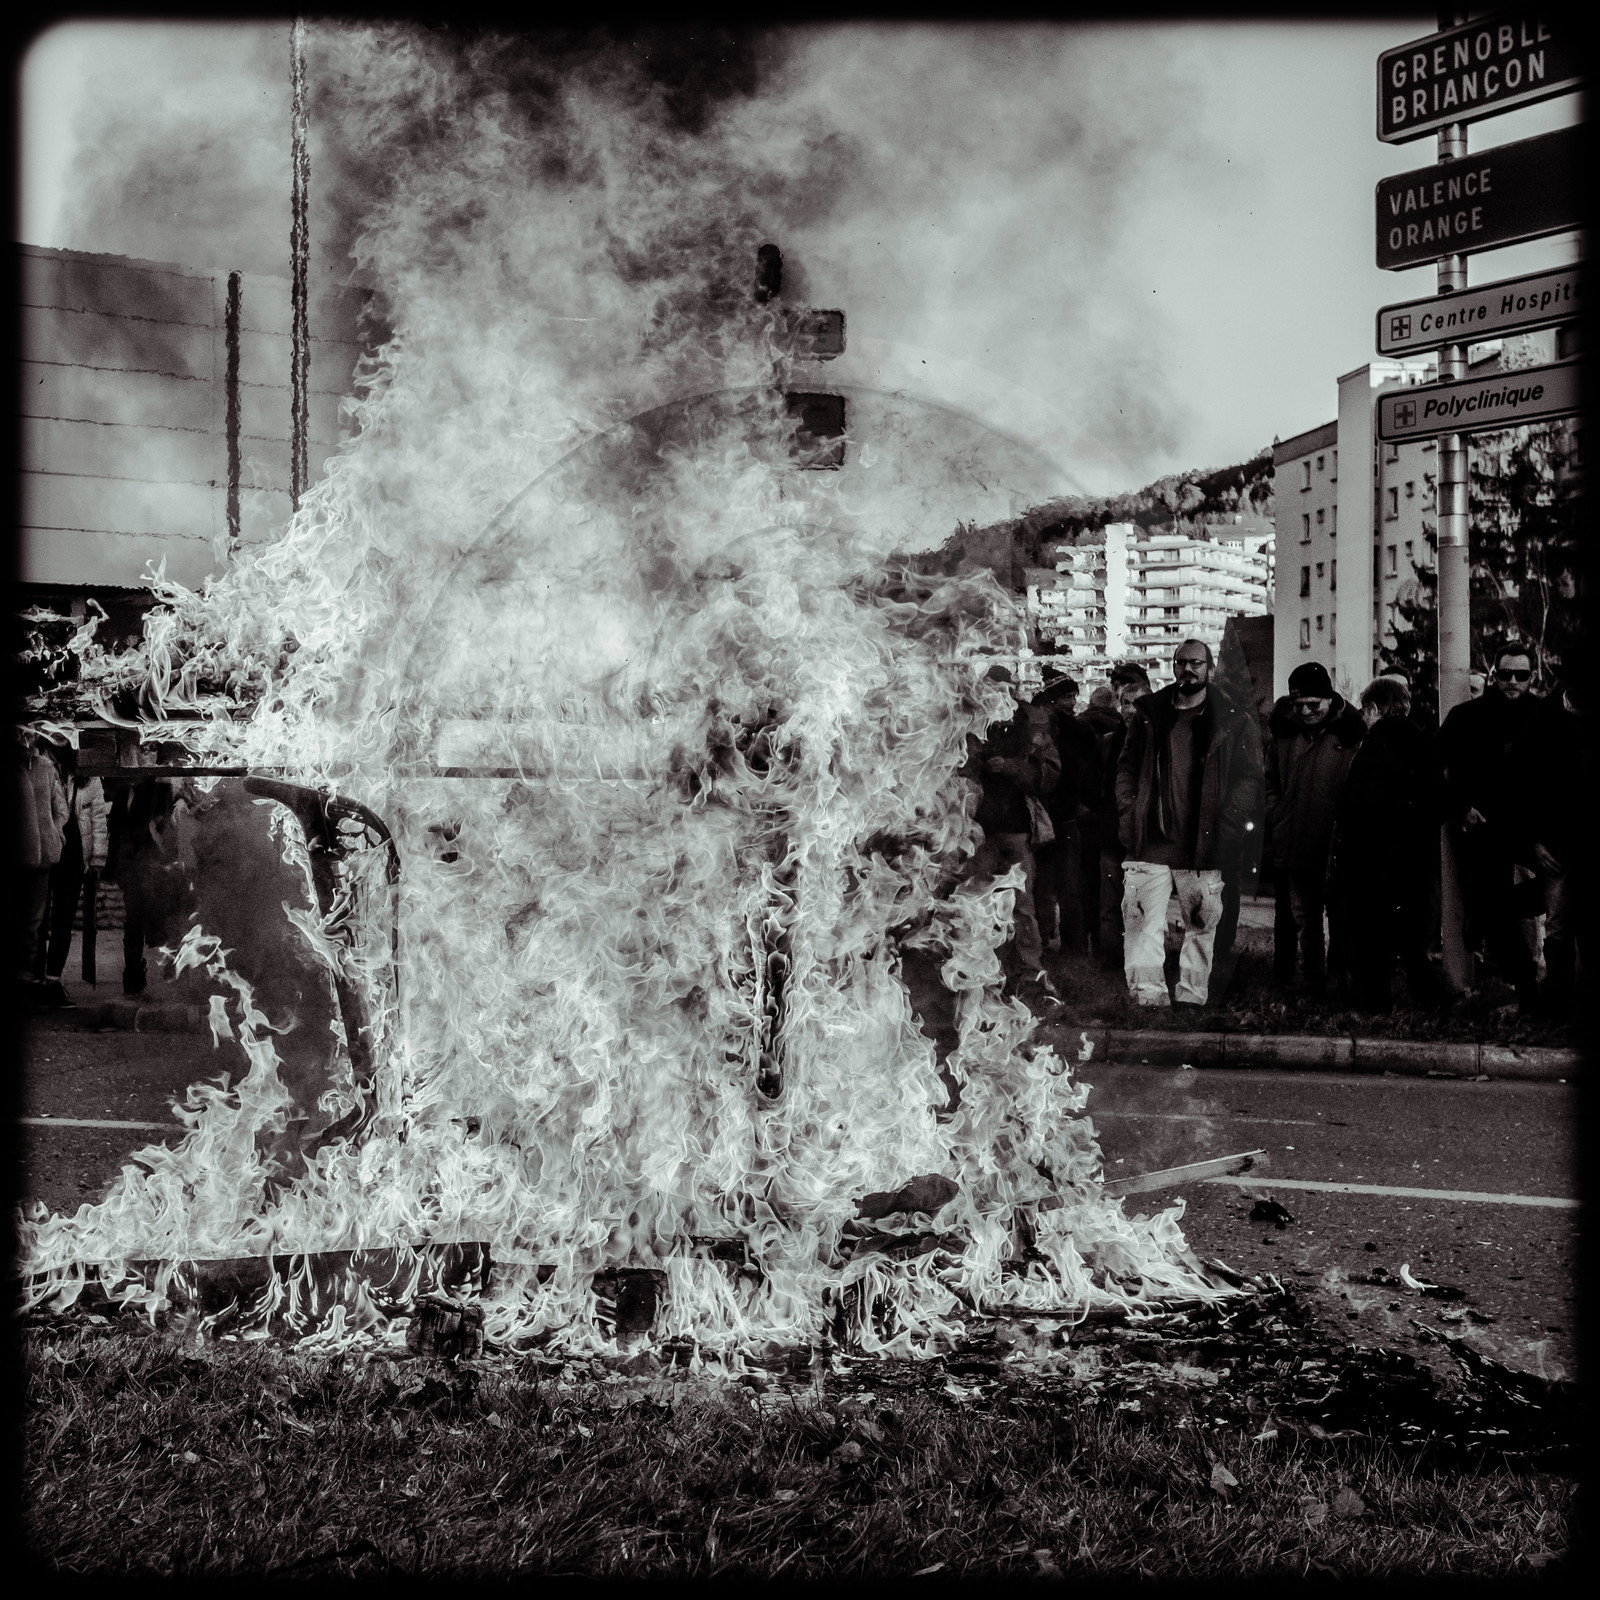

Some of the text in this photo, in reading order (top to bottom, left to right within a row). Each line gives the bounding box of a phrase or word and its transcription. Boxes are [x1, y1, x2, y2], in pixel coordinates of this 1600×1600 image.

[1391, 15, 1552, 88] GRENOBLE
[1392, 50, 1545, 125] BRIANÇON
[1389, 168, 1492, 216] VALENCE
[1389, 206, 1484, 250] ORANGE
[1420, 305, 1487, 332] Centre
[1423, 385, 1544, 419] Polyclinique
